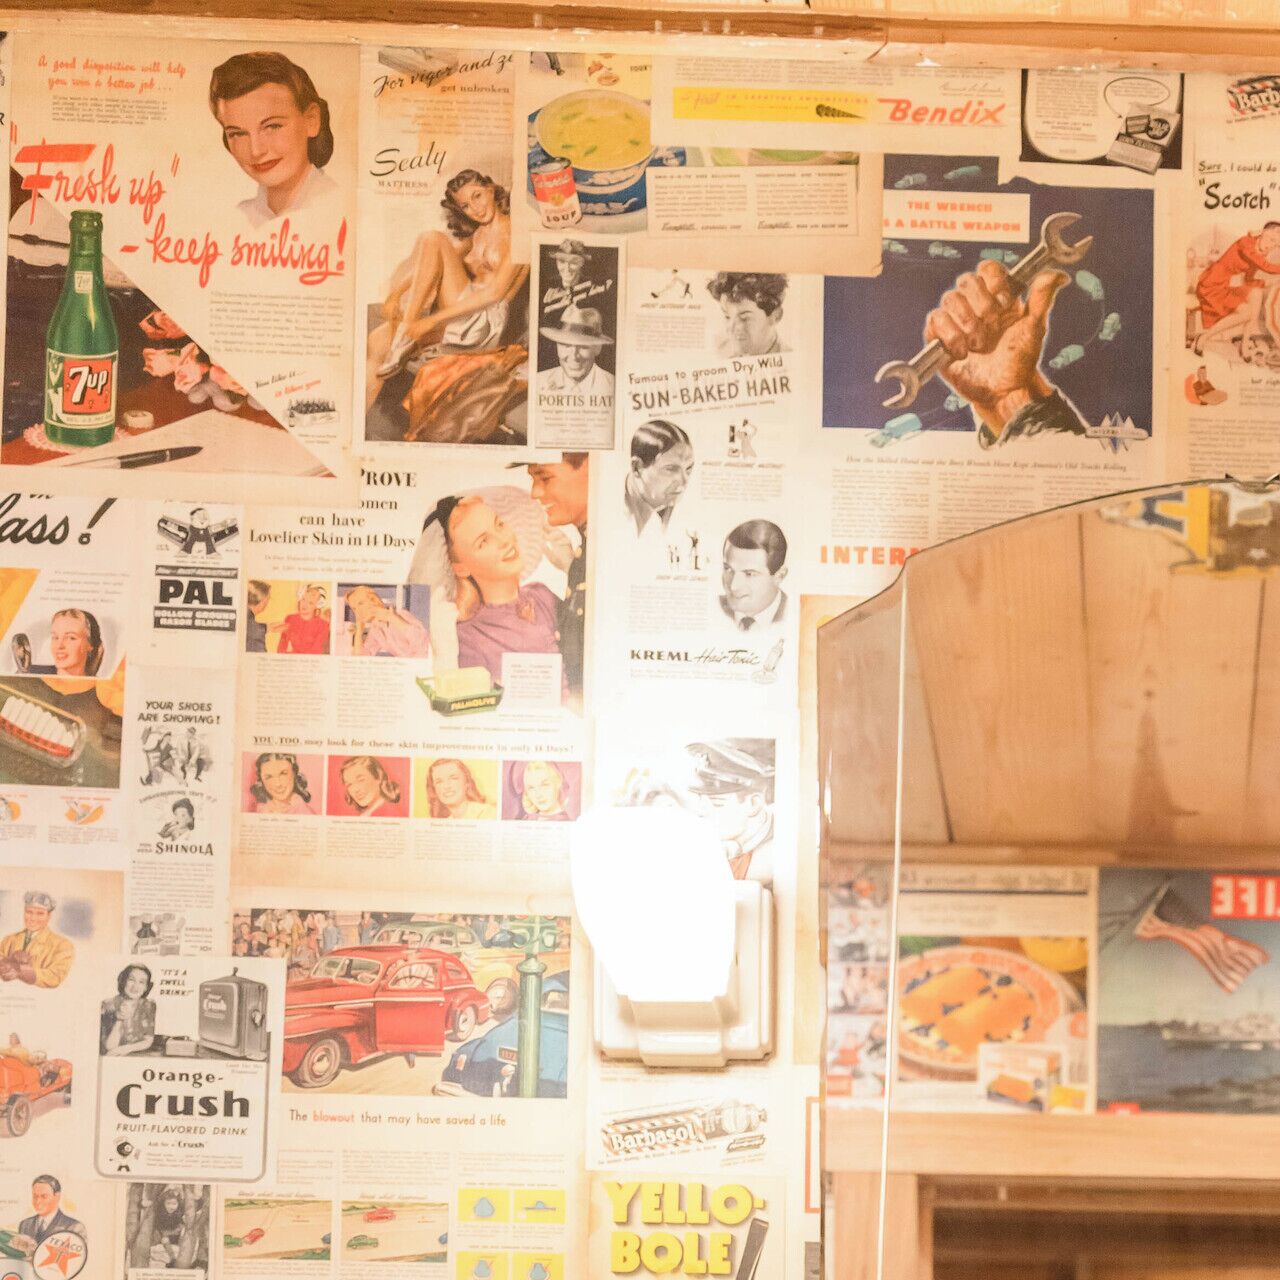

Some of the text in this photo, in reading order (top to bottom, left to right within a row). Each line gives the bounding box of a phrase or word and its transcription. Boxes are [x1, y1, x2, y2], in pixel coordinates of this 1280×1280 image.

[53, 57, 76, 72] good
[140, 60, 161, 74] will
[167, 58, 187, 78] help
[48, 78, 67, 91] you
[373, 57, 495, 98] For vigor and
[441, 84, 510, 94] get unbroken
[878, 97, 1006, 126] Bendix
[370, 142, 447, 176] Sealy
[1236, 162, 1262, 173] could
[1266, 162, 1277, 172] do
[378, 180, 429, 189] MATTRESS
[908, 200, 993, 213] THE WRENCH
[910, 220, 1021, 232] BATTLE WEAPON
[231, 216, 347, 286] smiling!
[628, 356, 783, 386] Famous to groom Wild
[69, 366, 108, 404] 7up
[747, 375, 792, 396] HAIR
[538, 394, 584, 408] PORTIS
[300, 513, 366, 527] can have
[250, 530, 415, 551] Lovelier Skin in Days
[159, 578, 233, 606] PAL
[630, 649, 692, 662] KREML
[145, 701, 212, 712] YOUR SHOES
[138, 713, 159, 723] ARE
[369, 740, 494, 752] these skin improvements
[155, 842, 214, 856] SHINOLA
[116, 1083, 250, 1119] Crush
[289, 1109, 507, 1127] The blowout that may have saved life
[116, 1123, 249, 1136] FRUIT-FLAVORED DRINK
[610, 1122, 697, 1152] Barbasol
[50, 1237, 83, 1252] TEXACO
[611, 1230, 734, 1276] BOLE
